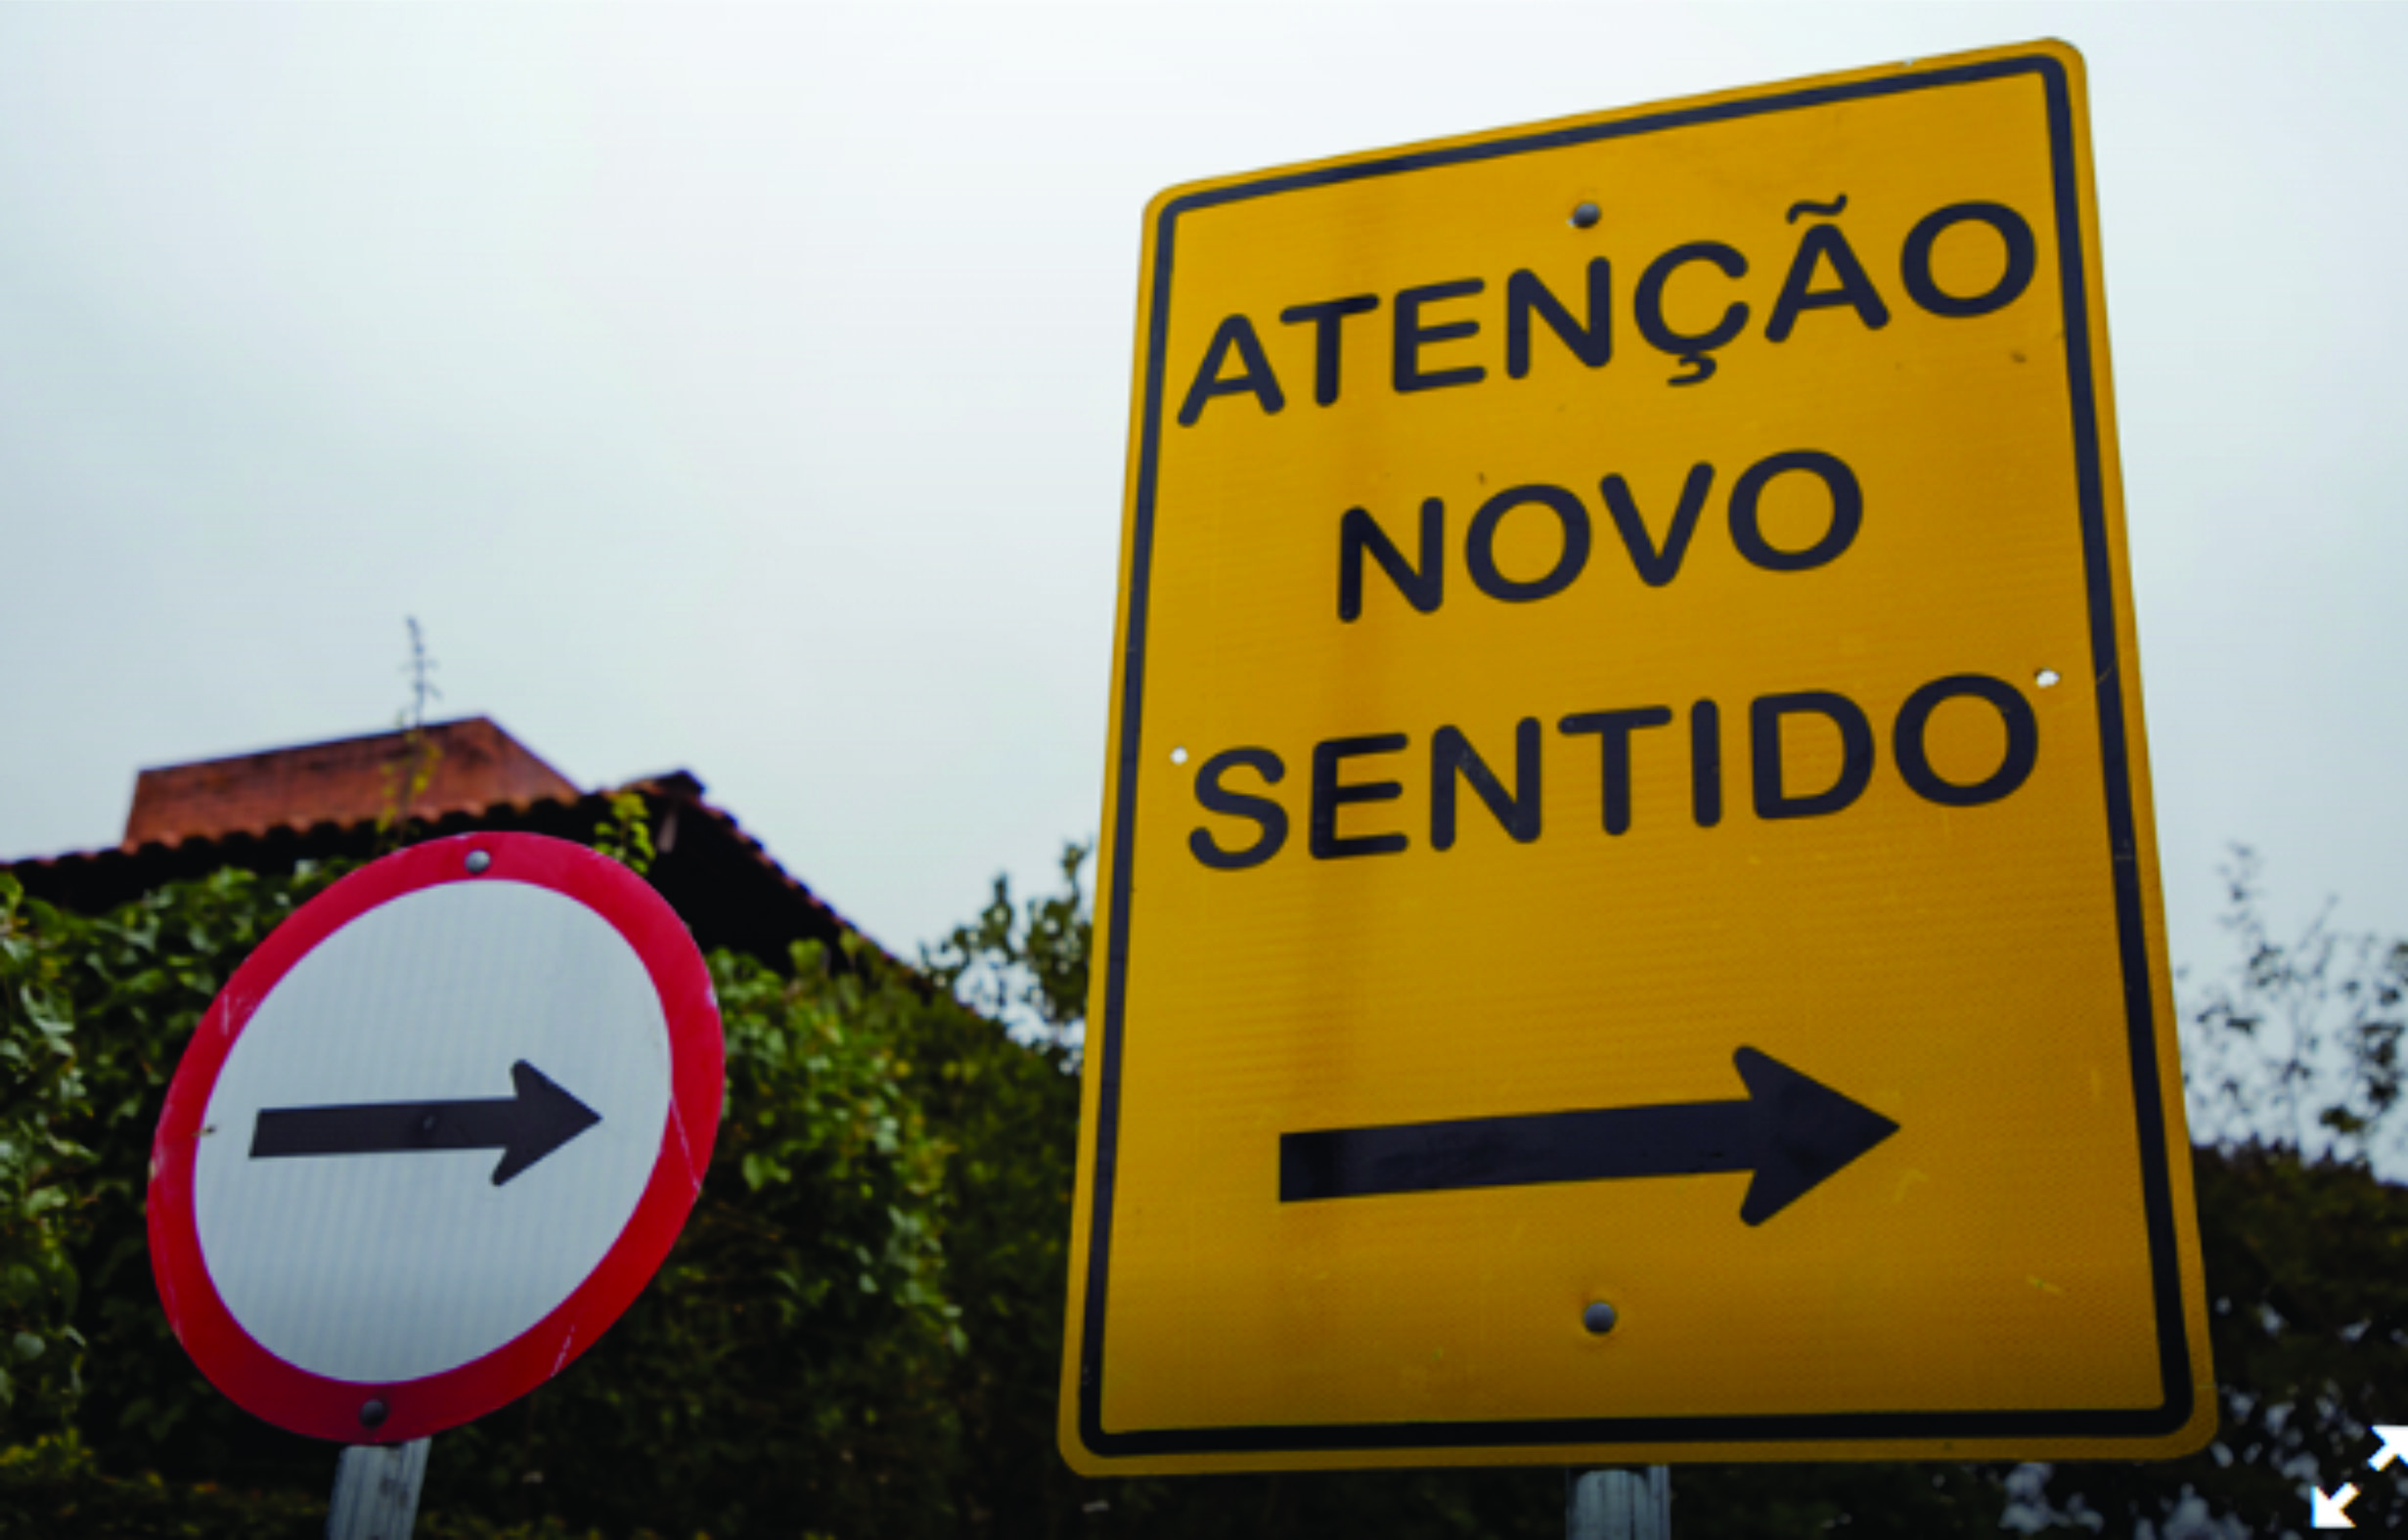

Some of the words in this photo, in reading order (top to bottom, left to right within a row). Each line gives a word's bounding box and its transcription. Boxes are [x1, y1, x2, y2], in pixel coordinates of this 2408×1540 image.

[1177, 193, 2038, 427] ATENÇÃO
[1336, 449, 1863, 624] NOVO
[1188, 673, 2040, 871] SENTIDO
